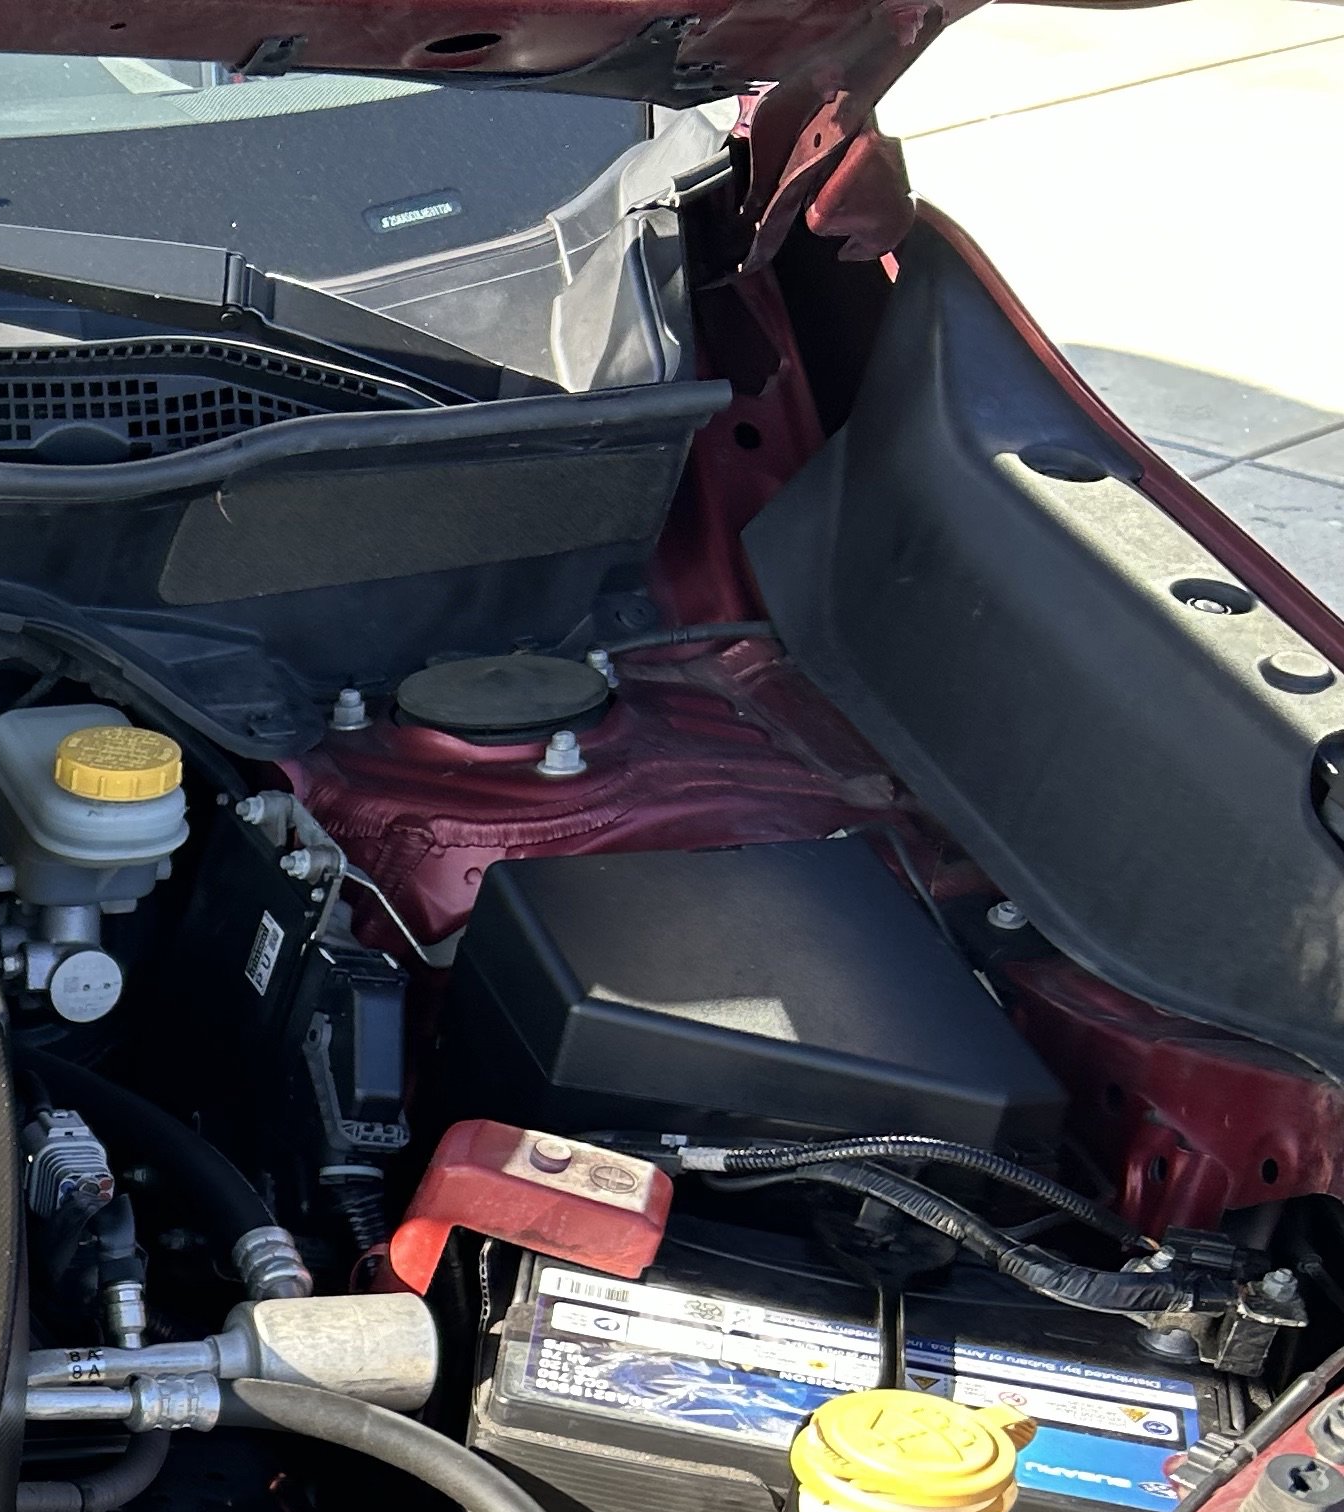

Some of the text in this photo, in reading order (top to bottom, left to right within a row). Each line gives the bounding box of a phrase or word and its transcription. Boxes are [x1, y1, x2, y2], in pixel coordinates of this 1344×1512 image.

[989, 1352, 1003, 1362] of
[1006, 1355, 1057, 1372] Subaru
[1084, 1368, 1162, 1389] Distributed
[1025, 1461, 1132, 1489] SUBARU
